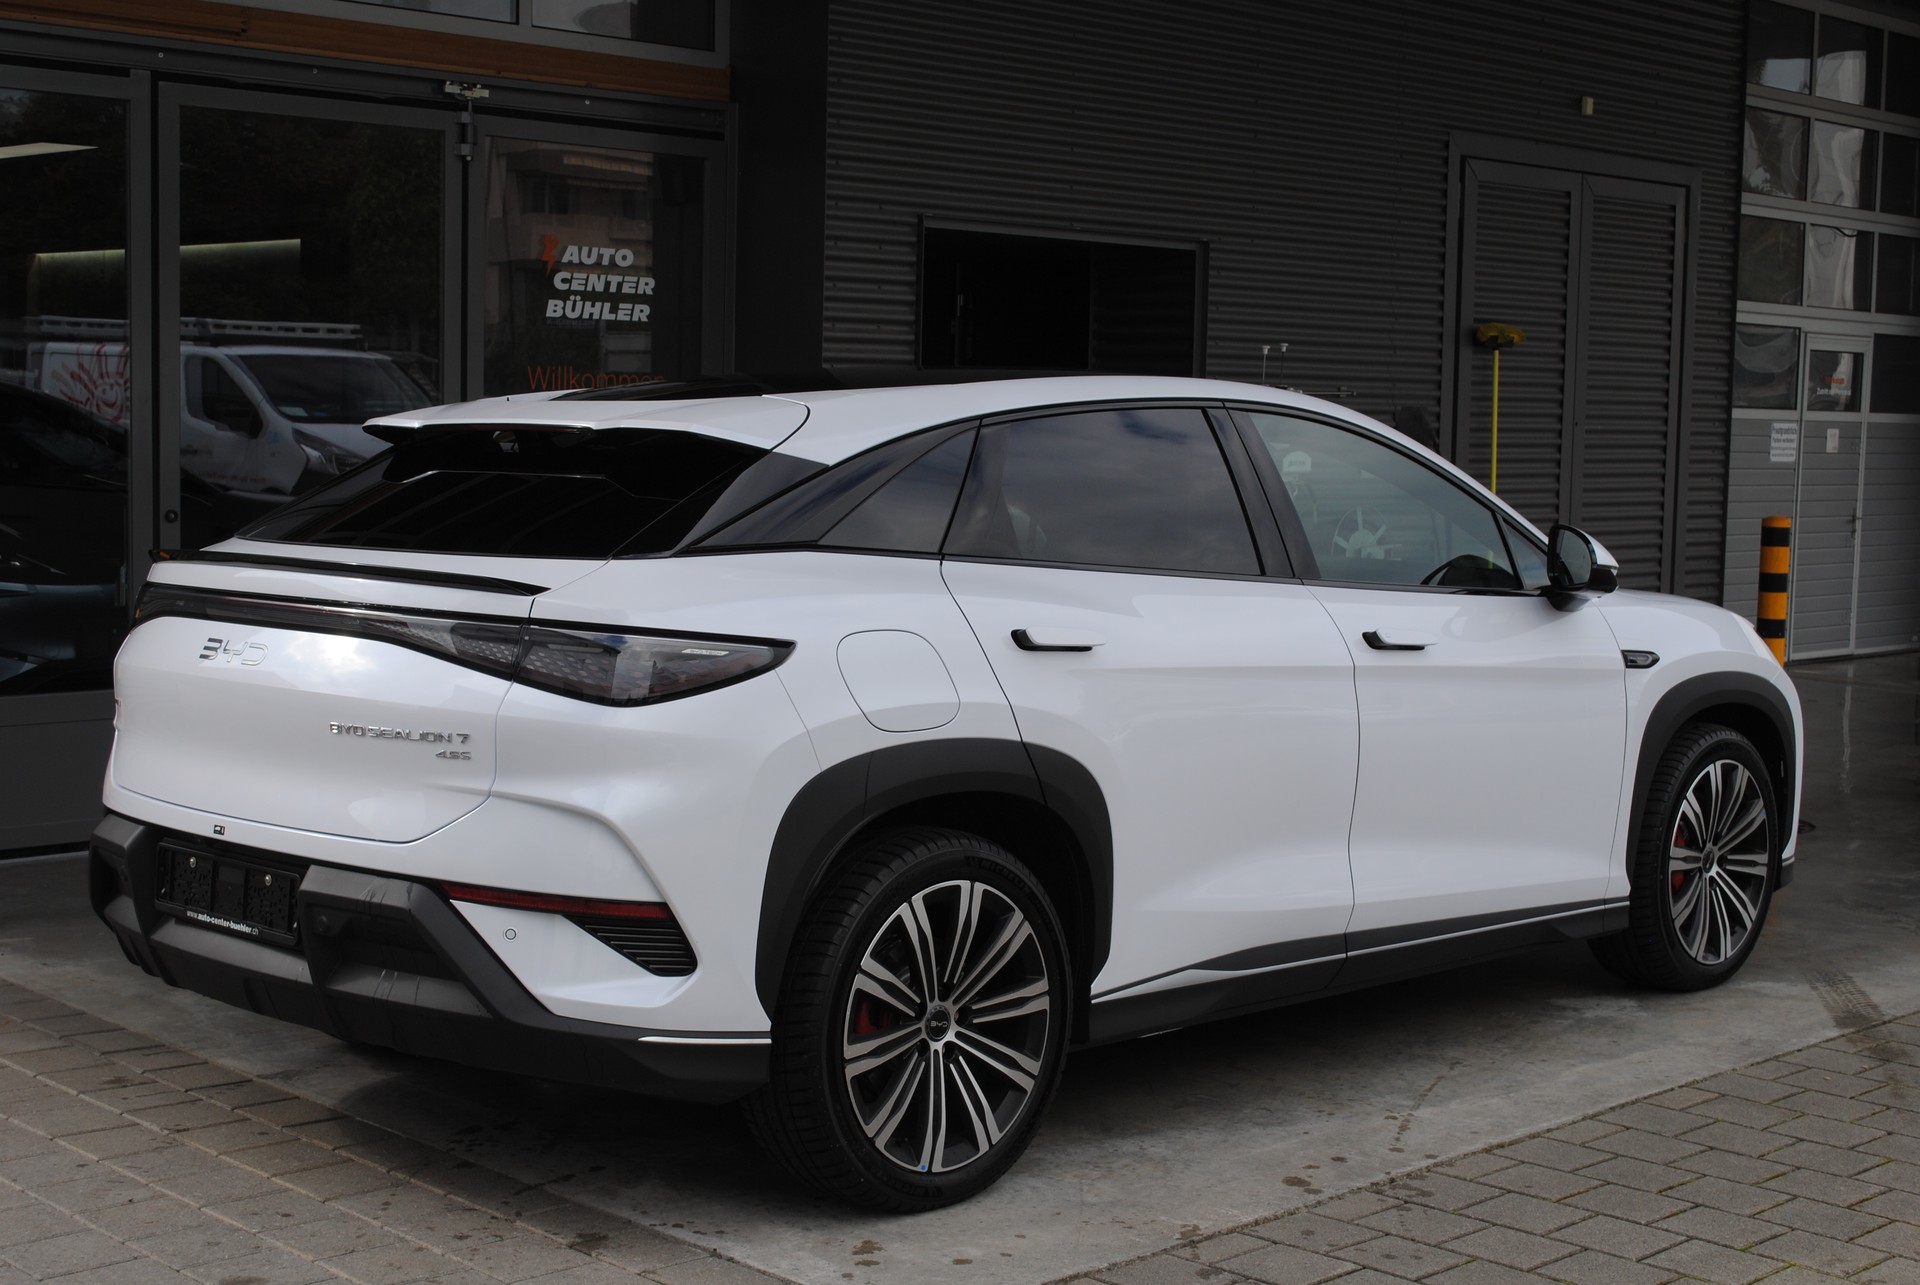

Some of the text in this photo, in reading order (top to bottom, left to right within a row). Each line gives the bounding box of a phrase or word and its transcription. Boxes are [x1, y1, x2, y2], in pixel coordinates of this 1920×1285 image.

[561, 245, 634, 267] AUTO
[553, 271, 656, 295] CENTER
[545, 295, 651, 322] BÜHLER
[199, 637, 268, 666] BYD
[367, 725, 453, 743] SEALION
[456, 733, 471, 744] 7
[186, 910, 259, 936] www.auto-center-buehler.ch
[930, 1020, 948, 1028] BYD
